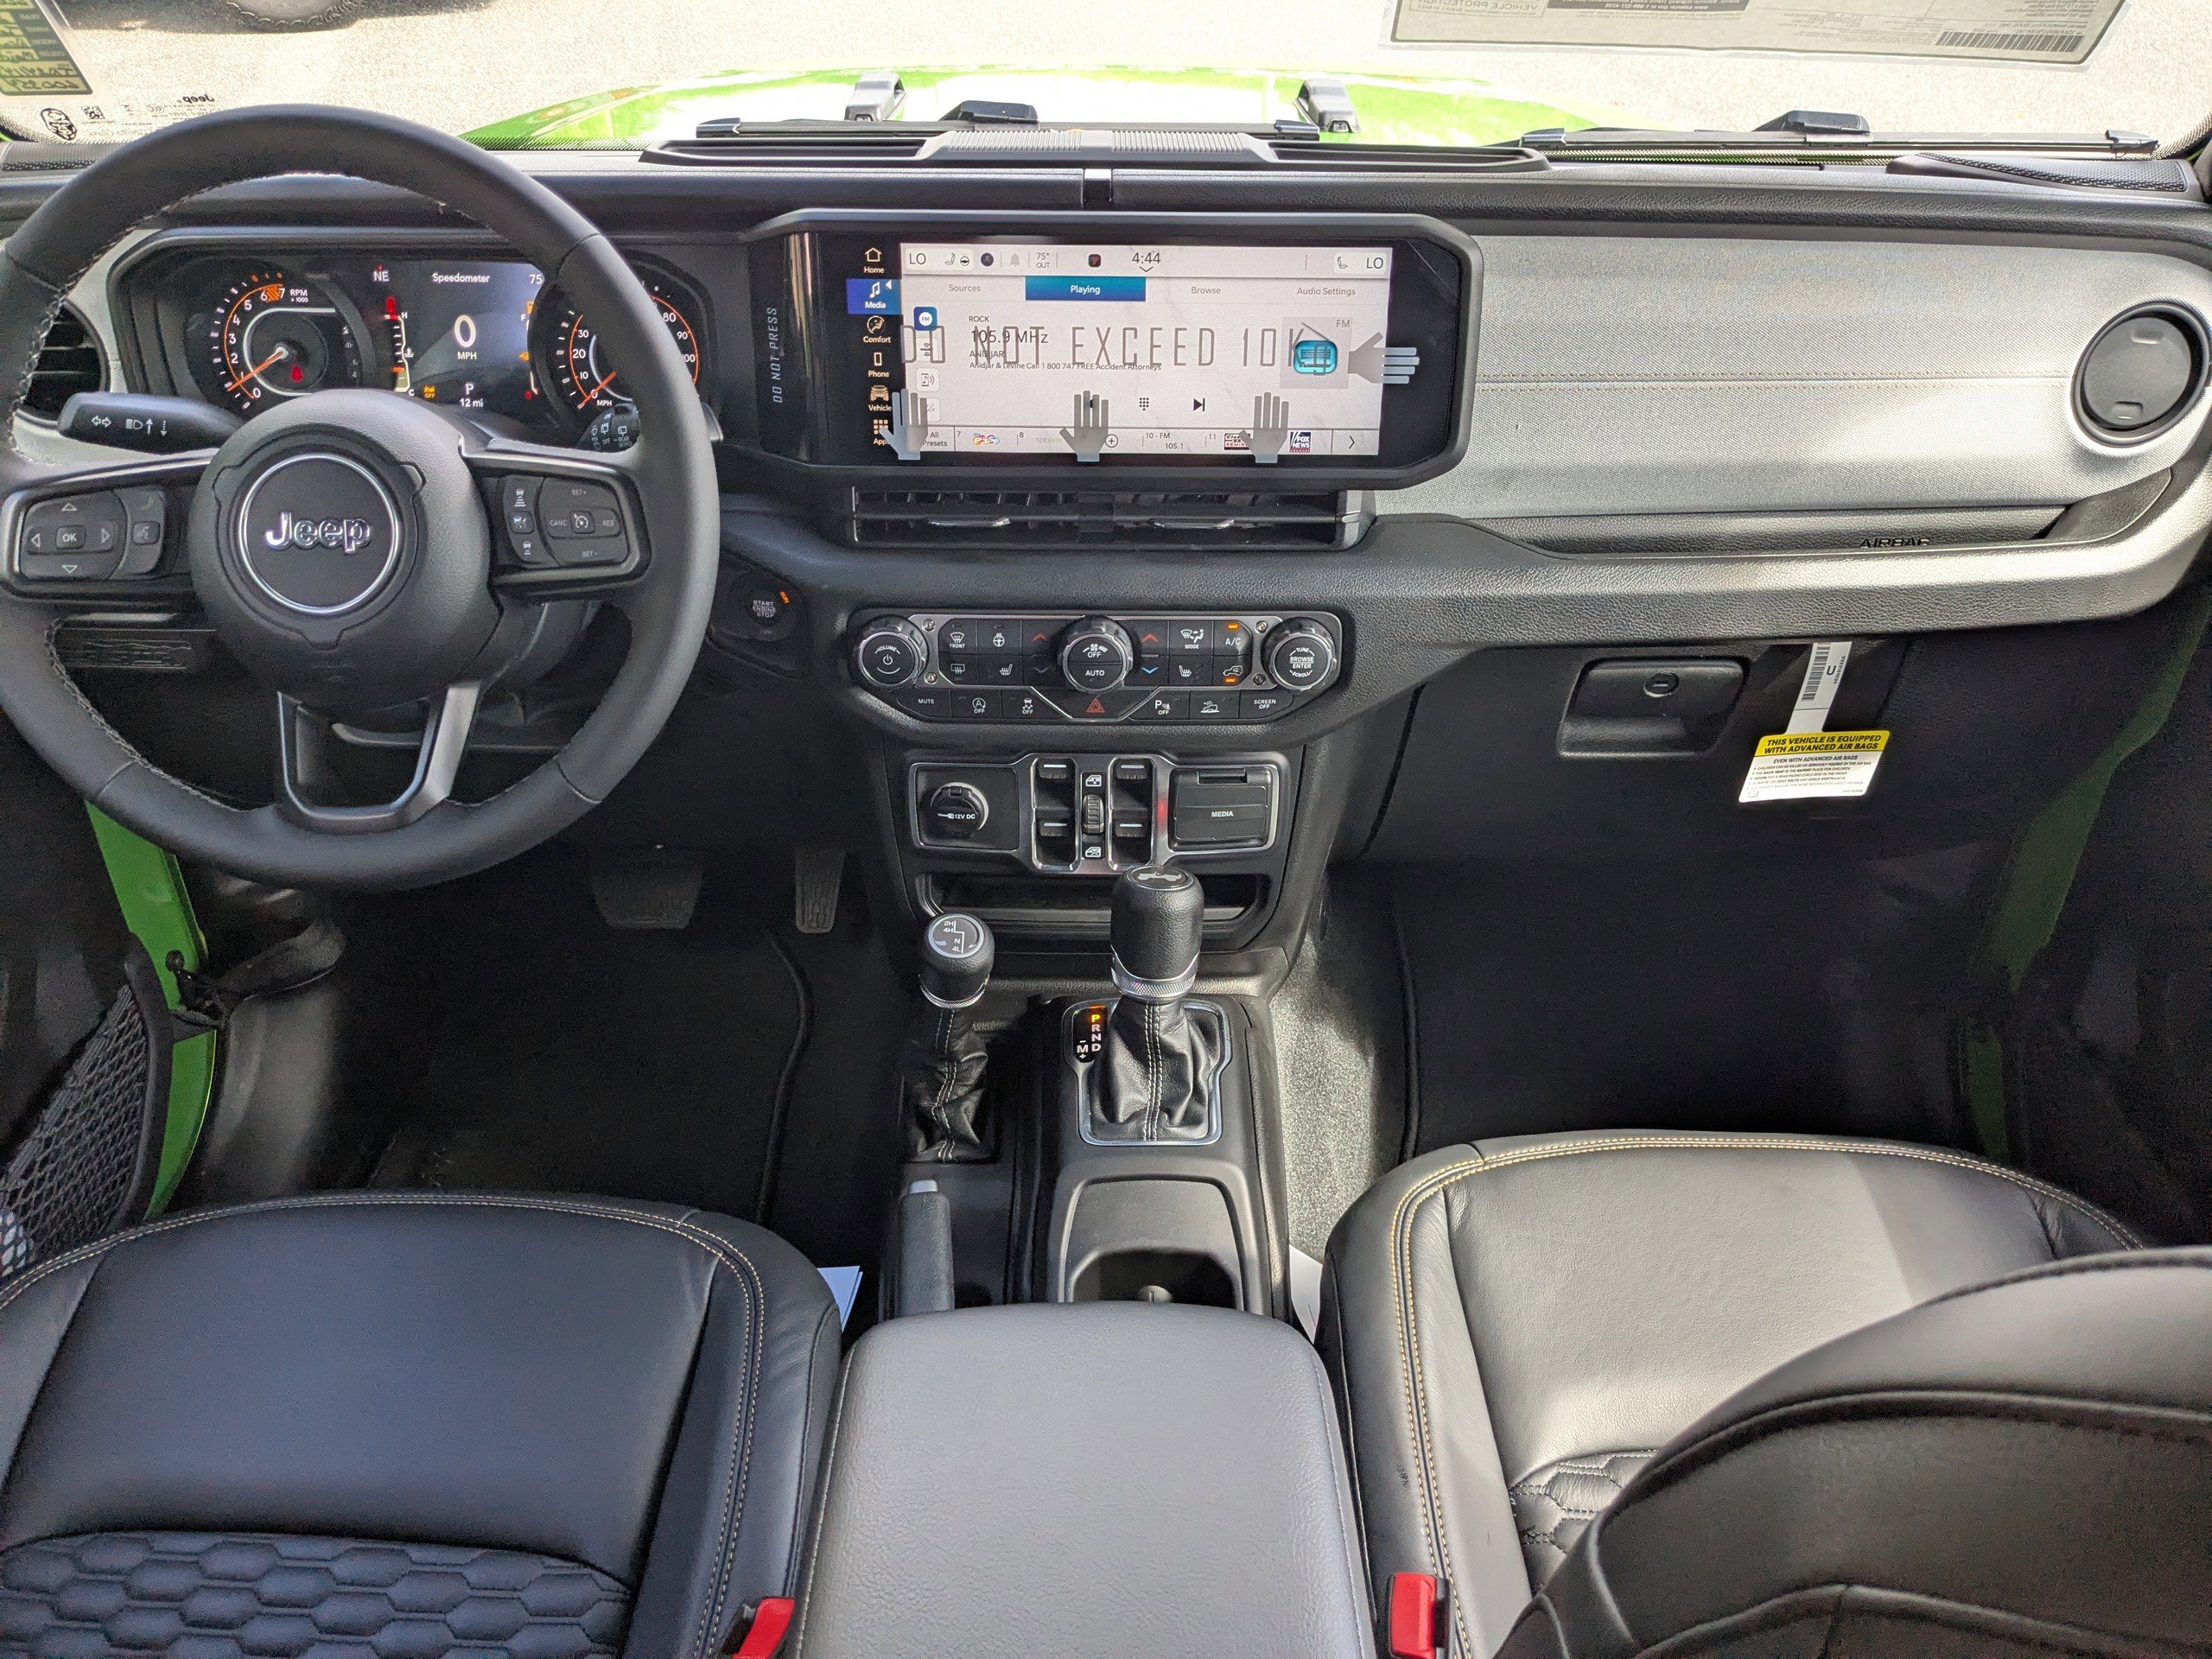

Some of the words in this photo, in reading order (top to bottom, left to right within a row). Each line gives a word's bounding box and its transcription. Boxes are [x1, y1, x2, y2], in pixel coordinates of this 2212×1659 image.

[909, 252, 926, 265] LO
[1132, 252, 1161, 264] 4:44
[1366, 257, 1383, 270] LO
[373, 270, 390, 282] NE
[432, 272, 491, 283] Speedometer
[278, 288, 286, 299] 7
[949, 283, 982, 293] Sources
[1071, 285, 1101, 296] Playing
[1191, 286, 1221, 296] Browse
[1296, 286, 1321, 296] Audio
[1323, 287, 1356, 297] Settings
[261, 291, 268, 302] 6
[244, 300, 252, 311] 5
[865, 301, 887, 309] Media
[232, 315, 240, 326] 4
[663, 312, 677, 322] 80
[766, 307, 779, 350] PRESS
[1336, 319, 1351, 327] FM
[454, 314, 476, 348] 0
[577, 329, 589, 339] 30
[677, 331, 689, 340] 90
[228, 333, 237, 345] 3
[1017, 330, 1049, 344] MHz
[974, 326, 1046, 365] NOT
[1071, 327, 1215, 367] EXCEED
[231, 353, 238, 364] 2
[572, 349, 587, 359] 20
[770, 355, 781, 380] NOT
[580, 371, 589, 379] 10
[252, 388, 262, 398] 0
[465, 384, 474, 395] P
[772, 386, 783, 404] DO
[460, 398, 471, 407] 12
[473, 398, 484, 407] mi
[62, 533, 78, 543] OK
[264, 511, 372, 555] Jeep
[1225, 638, 1241, 646] A/C
[1826, 664, 1837, 676] U
[1154, 700, 1162, 709] P
[1789, 736, 1823, 745] VEHICLE
[1837, 734, 1882, 743] EQUIPPED
[1764, 746, 1786, 754] WITH
[1788, 743, 1836, 753] ADVANCED
[1091, 1014, 1101, 1023] P
[1077, 1044, 1089, 1053] M
[1091, 1043, 1102, 1052] D
